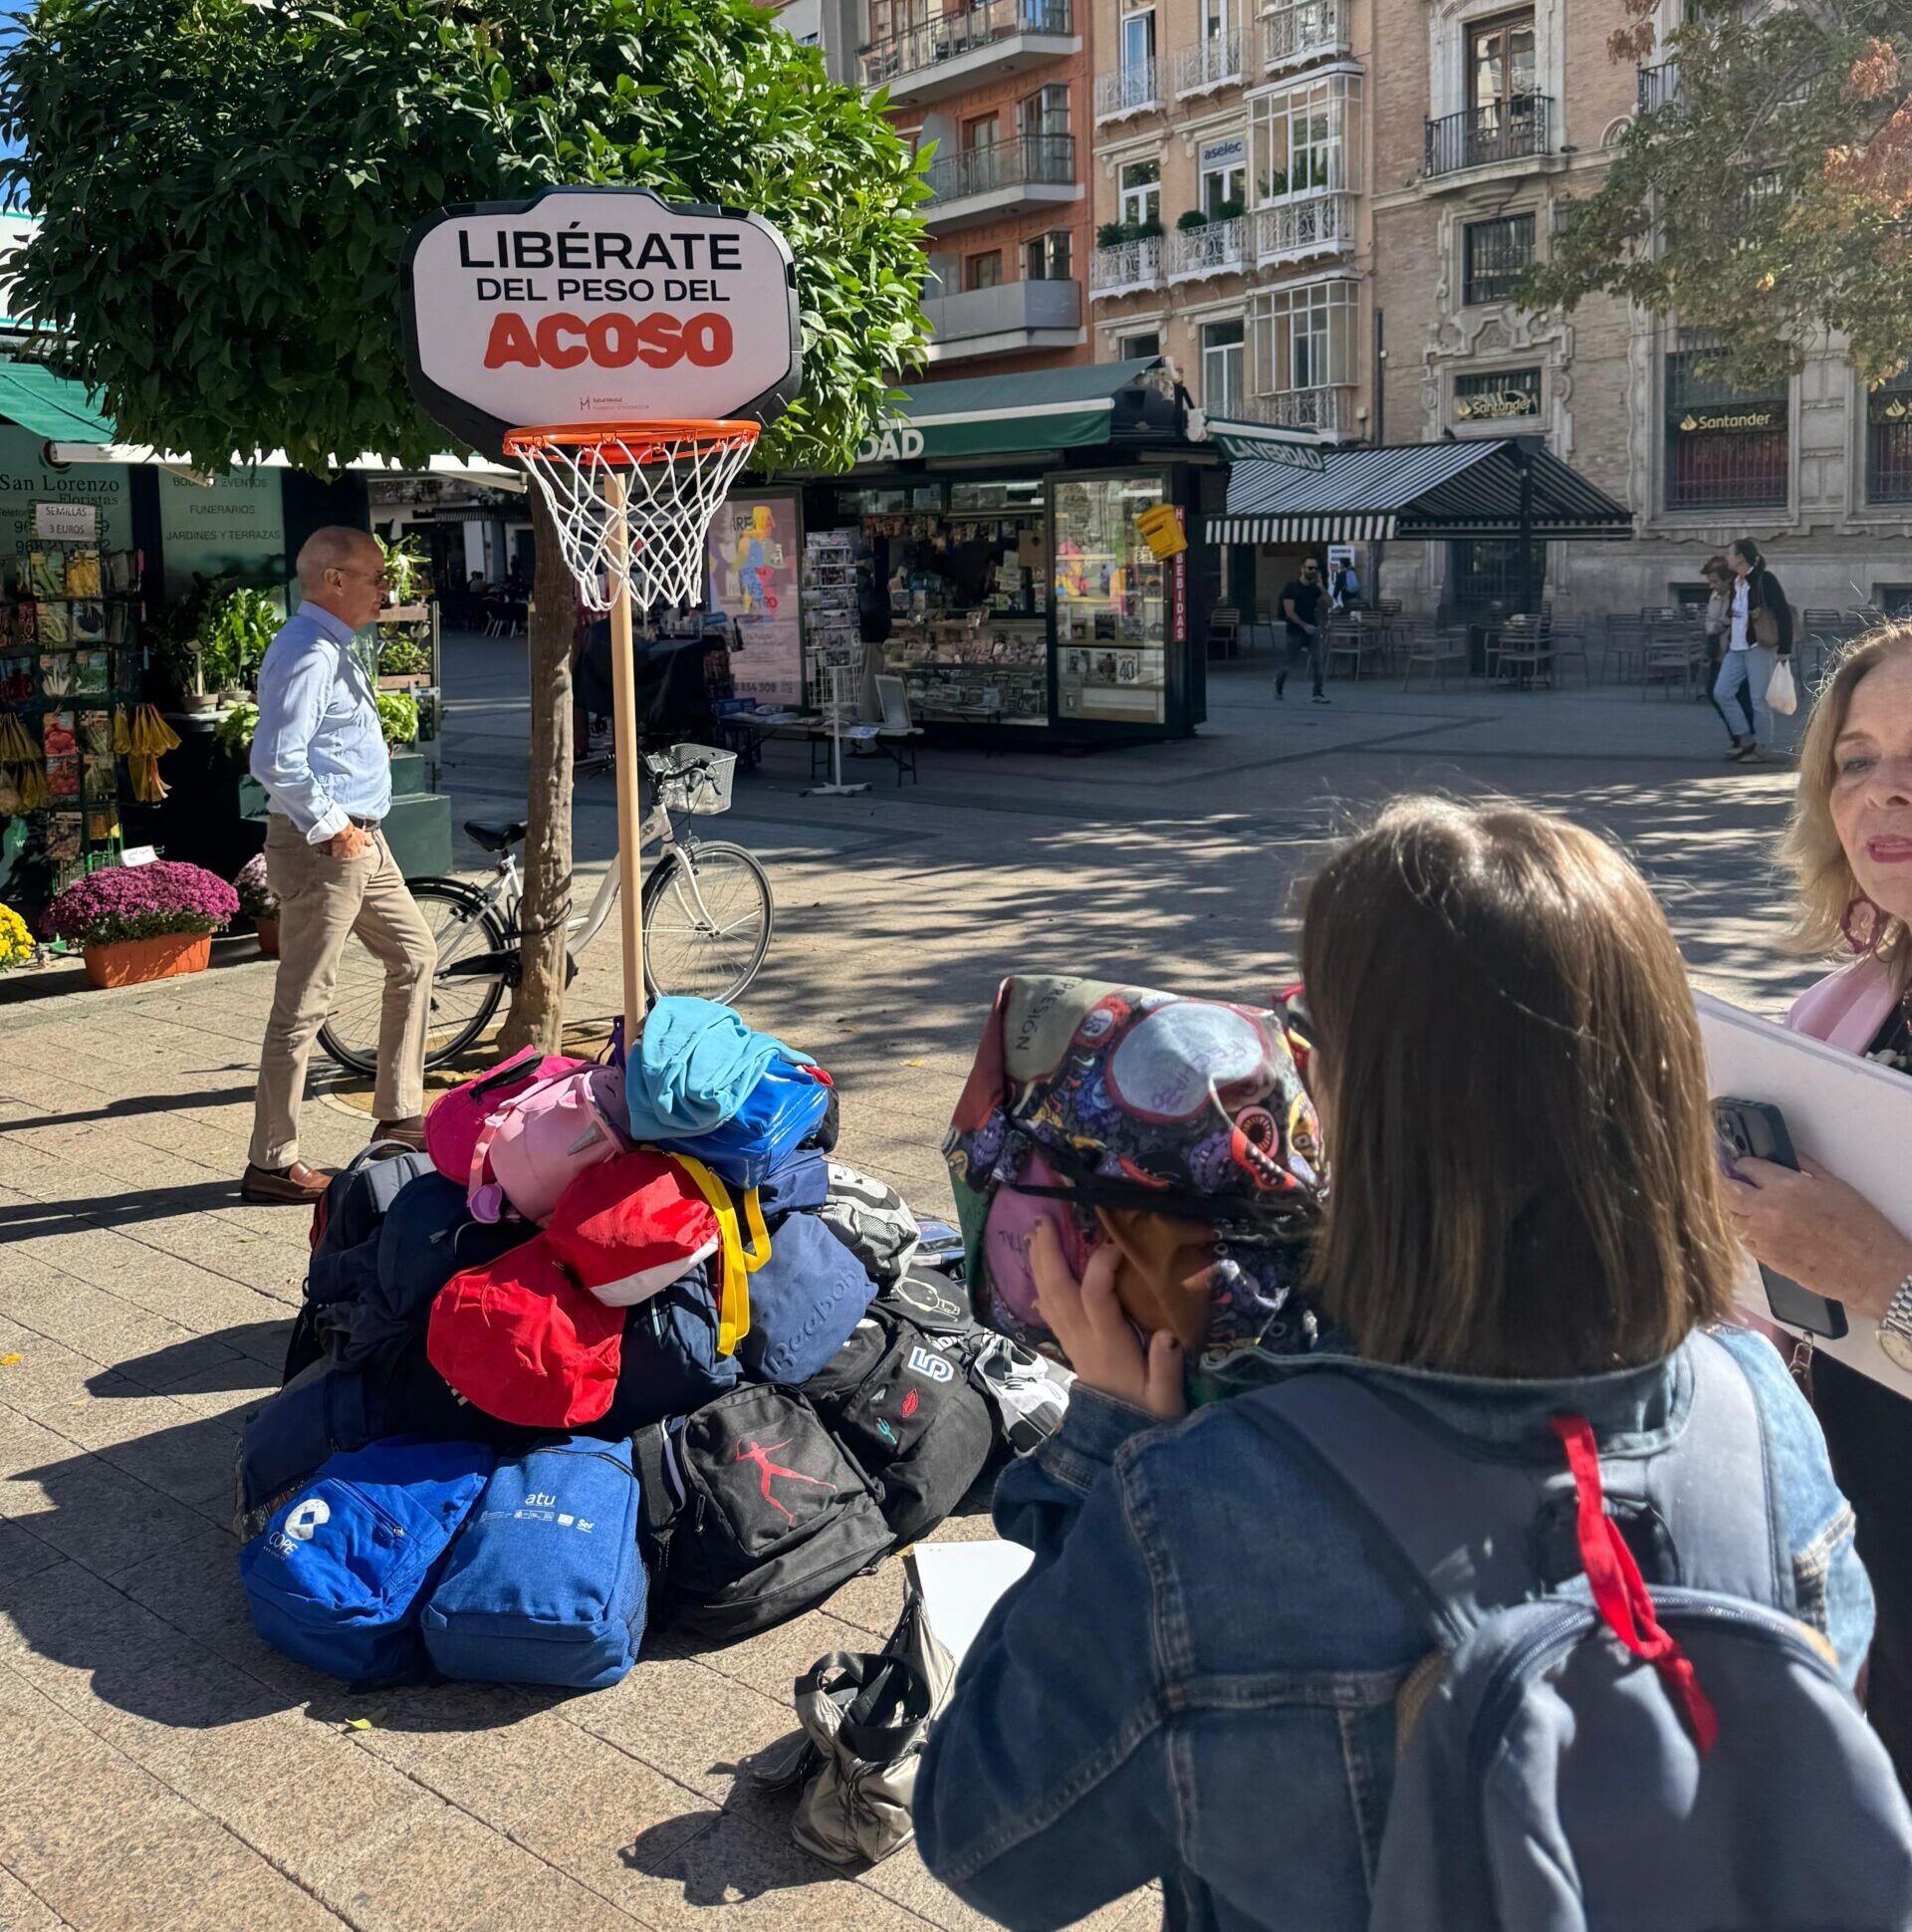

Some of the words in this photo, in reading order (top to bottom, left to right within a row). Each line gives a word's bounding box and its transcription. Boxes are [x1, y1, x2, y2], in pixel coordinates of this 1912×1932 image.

[1204, 141, 1242, 160] aselec
[458, 221, 742, 270] LIBÉRATE
[476, 278, 548, 301] DEL
[558, 278, 654, 302] PESO
[664, 279, 730, 302] DEL
[483, 312, 733, 369] ACOSO
[1473, 397, 1531, 414] Santander
[1699, 413, 1771, 429] Santander
[1256, 441, 1323, 470] VERDAD
[0, 474, 34, 491] San
[43, 475, 120, 492] Lorenzo
[46, 506, 87, 517] SEMILLAS
[189, 504, 256, 514] FUNERARIOS
[49, 525, 55, 534] 3
[57, 525, 85, 534] EUROS
[166, 531, 217, 540] JARDINES
[218, 531, 227, 540] Y
[229, 530, 281, 539] TERRAZAS
[1175, 550, 1185, 639] BEBIDAS
[525, 1492, 556, 1506] atu
[269, 1531, 299, 1555] COPE
